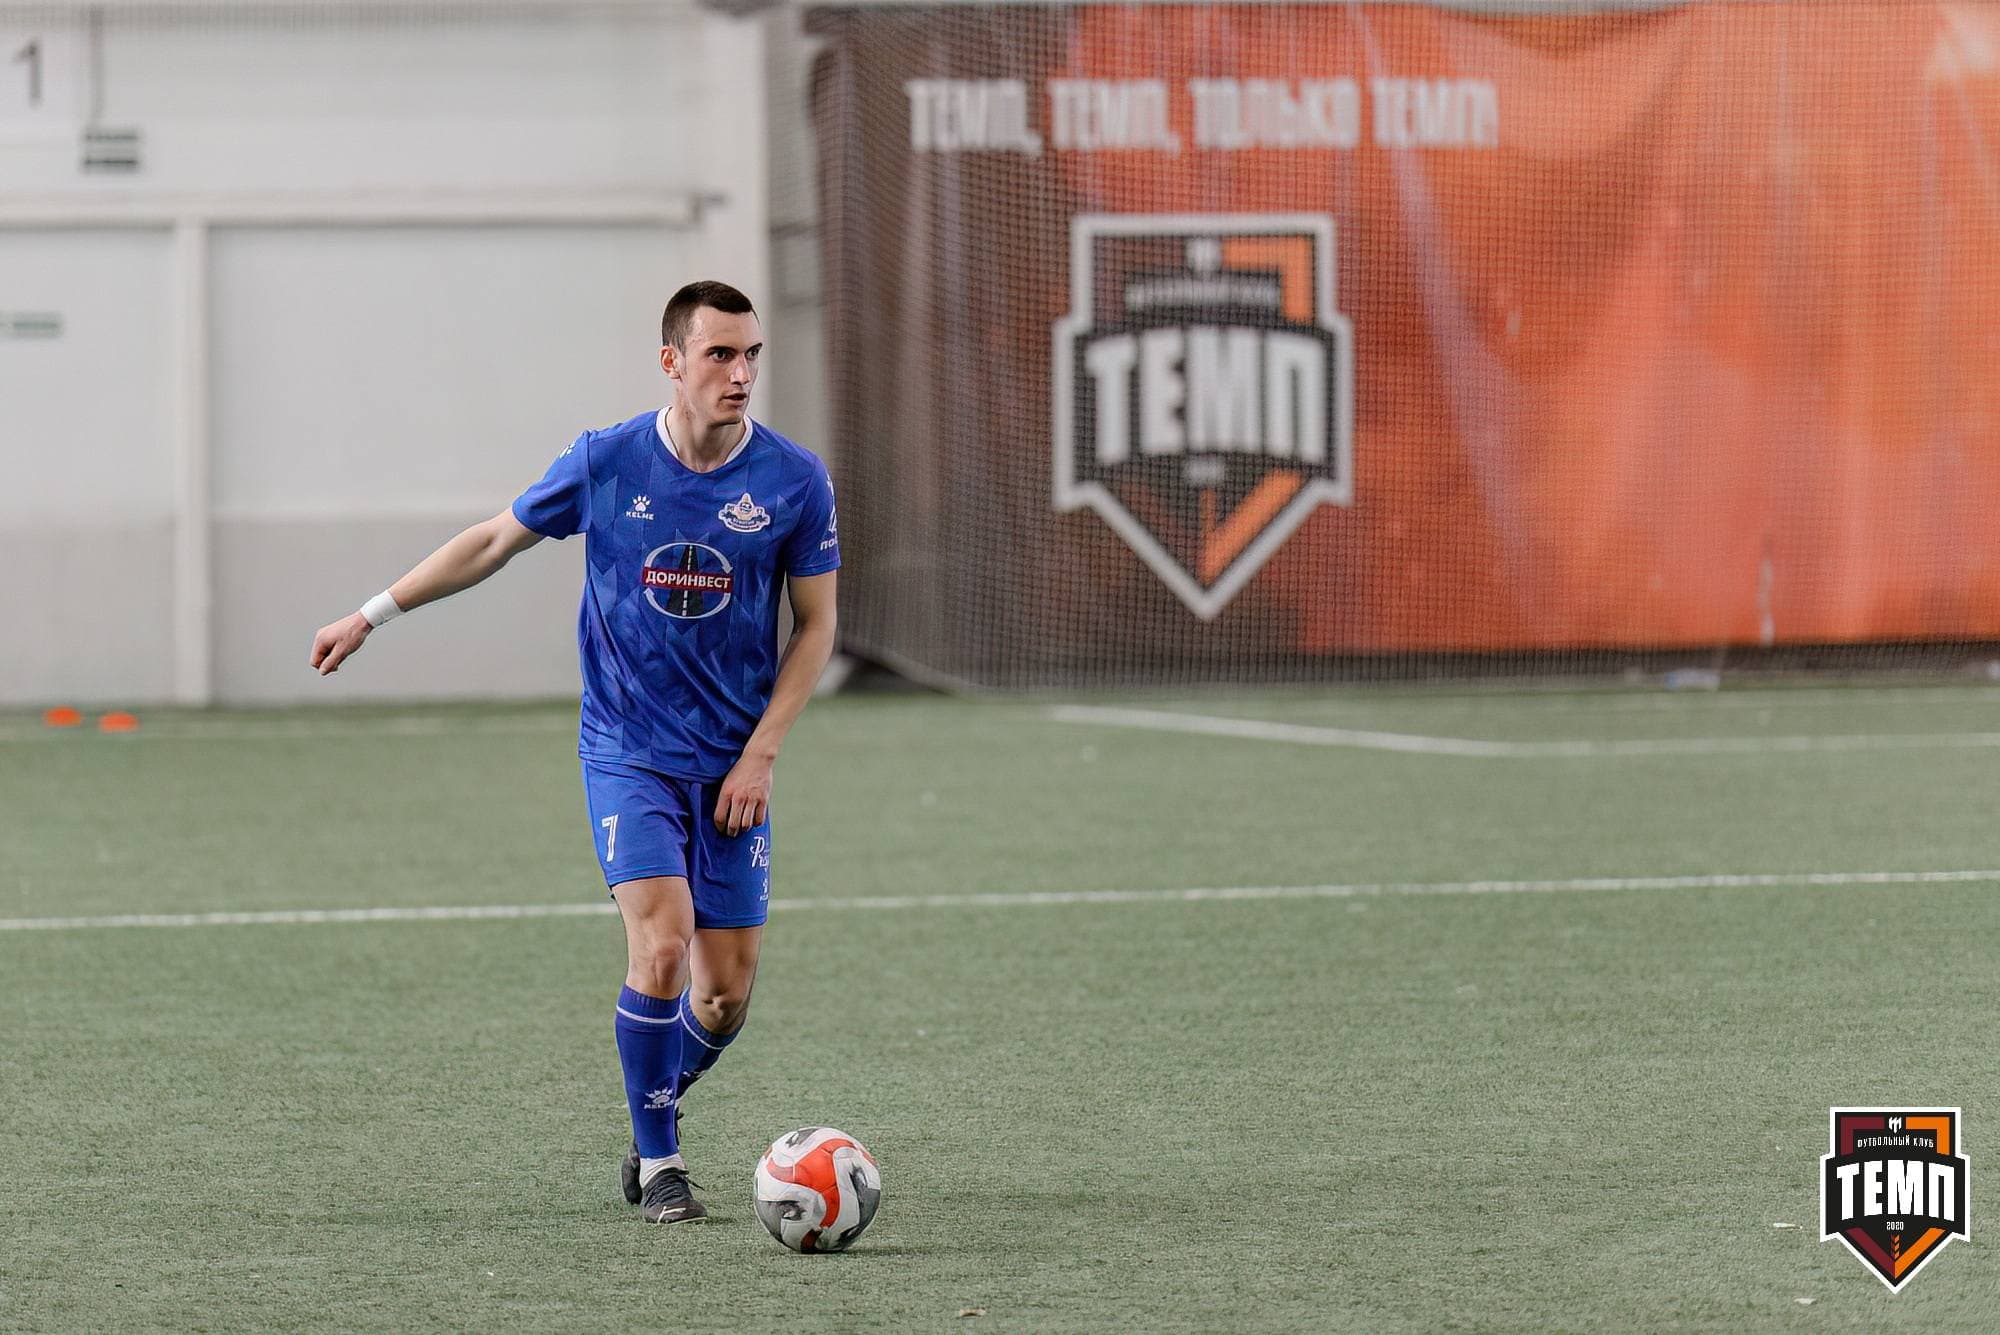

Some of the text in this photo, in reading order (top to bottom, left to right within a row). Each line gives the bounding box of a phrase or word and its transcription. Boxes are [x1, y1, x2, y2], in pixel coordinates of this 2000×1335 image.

[1087, 326, 1326, 464] ТЕМП
[625, 510, 654, 520] KELME
[645, 570, 731, 589] ДОРИНВЕСТ
[601, 814, 619, 862] 7
